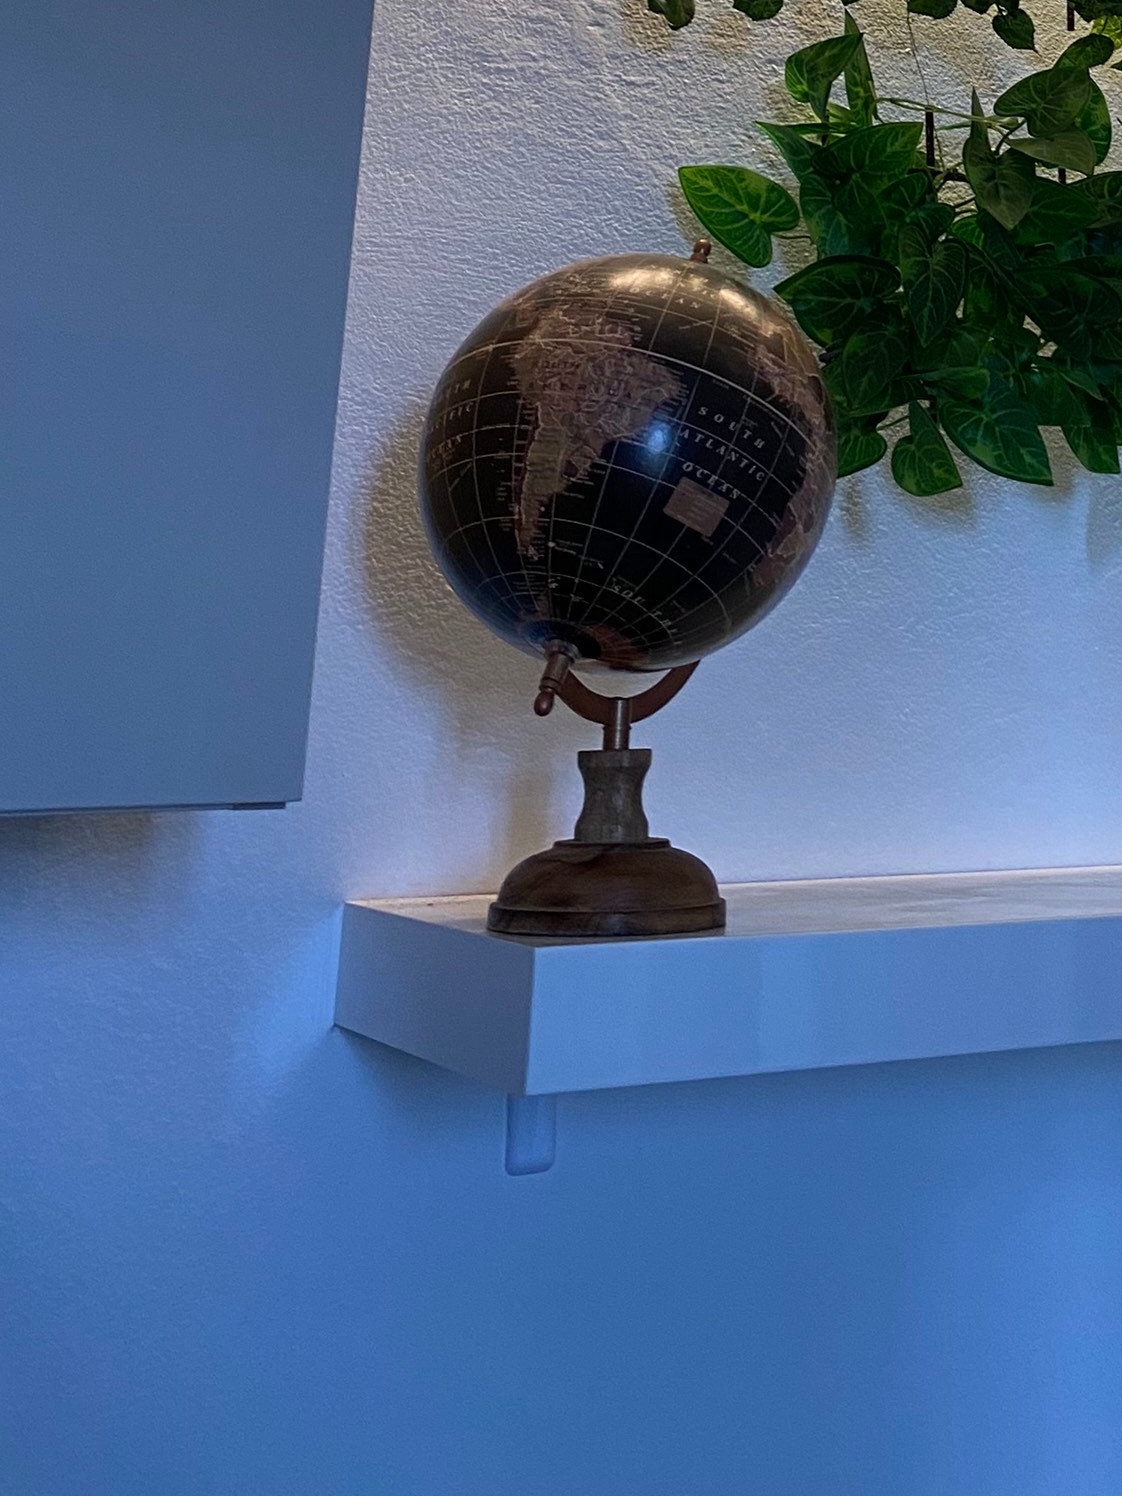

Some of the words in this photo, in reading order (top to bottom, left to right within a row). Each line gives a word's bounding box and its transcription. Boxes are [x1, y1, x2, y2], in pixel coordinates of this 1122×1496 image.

[698, 406, 765, 448] SOUTH
[680, 429, 765, 481] ATLANTIC
[682, 461, 740, 499] OCEAN
